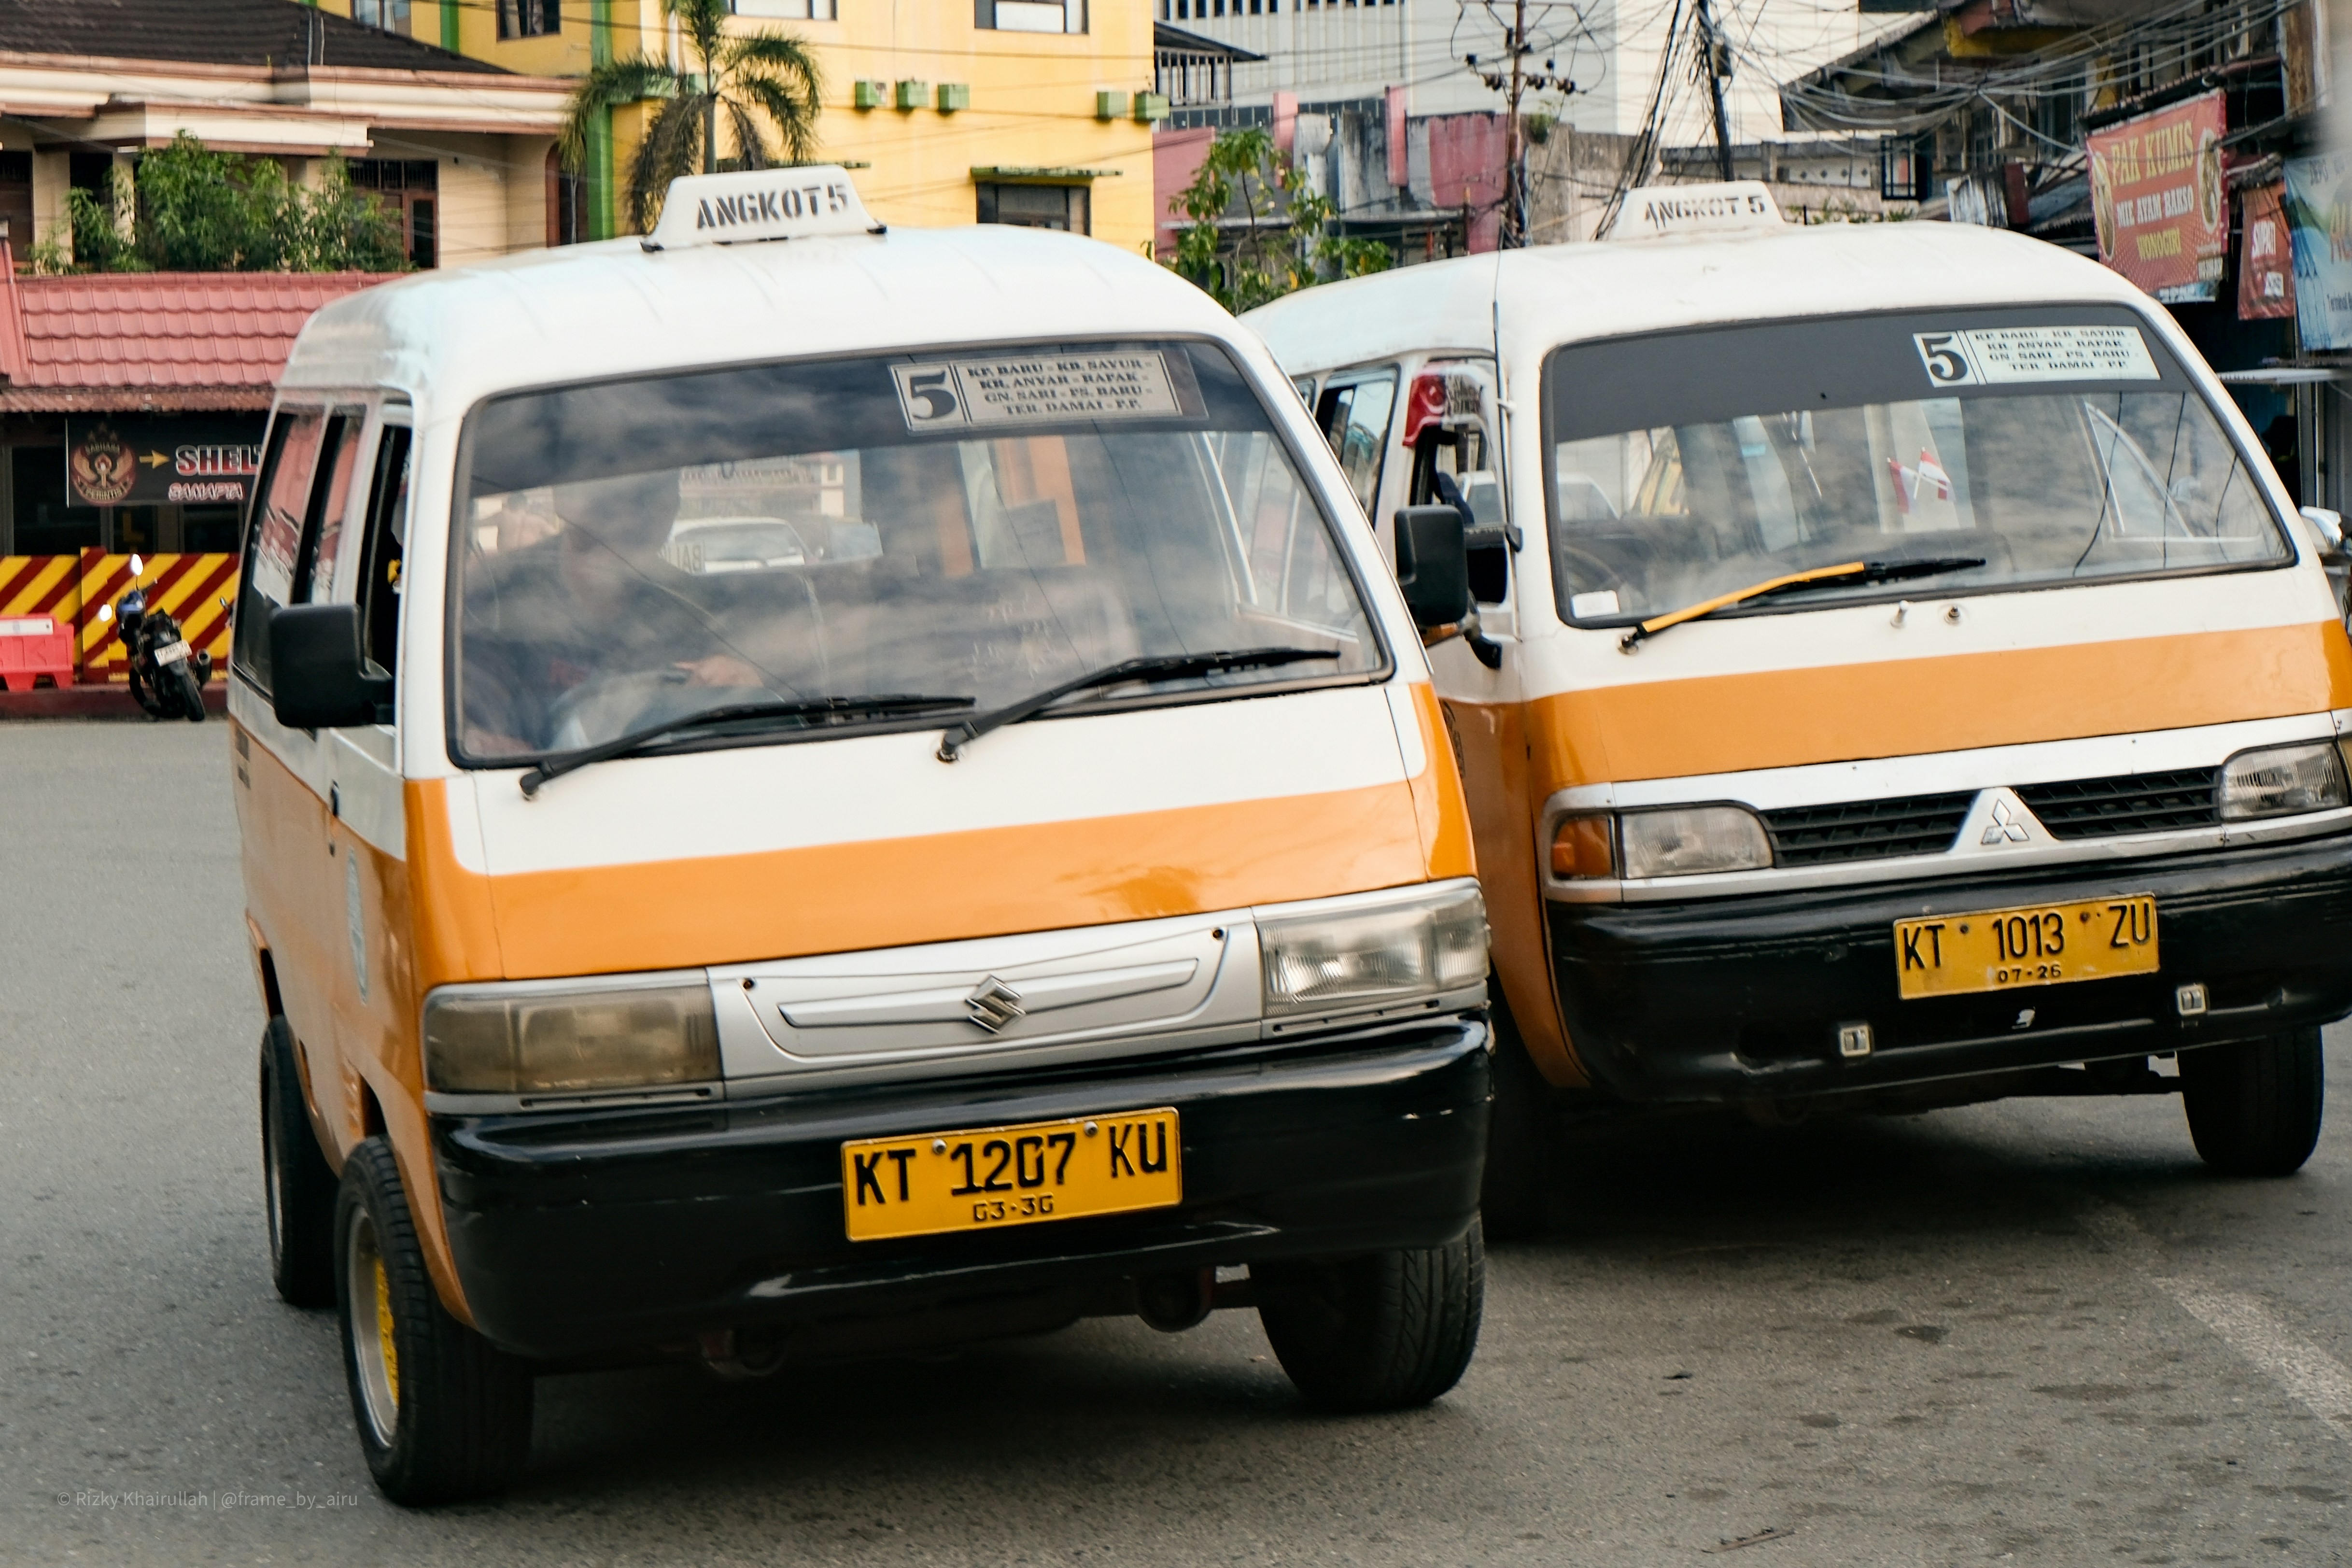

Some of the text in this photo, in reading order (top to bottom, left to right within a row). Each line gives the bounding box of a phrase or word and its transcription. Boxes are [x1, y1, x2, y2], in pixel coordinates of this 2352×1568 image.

[2111, 119, 2194, 186] PAK KUMIS
[697, 182, 848, 230] ANGKOT 5
[1747, 195, 1766, 214] 5
[2116, 183, 2195, 228] MIE AYAM BAKSO
[2000, 331, 2039, 339] BARU
[2080, 329, 2126, 338] SAYUR
[2017, 340, 2063, 350] ANYAR
[2076, 339, 2123, 348] RAPAK
[1921, 336, 1968, 381] 5
[2017, 351, 2052, 360] SARI
[2092, 350, 2130, 358] BARU
[997, 363, 1043, 375] BARU
[1087, 359, 1142, 370] SAYUR
[2048, 360, 2095, 369] DAMAI
[1013, 375, 1069, 387] ANYAR
[1082, 372, 1138, 383] RAPAK
[910, 370, 957, 419] 5
[1016, 388, 1057, 400] SARI
[1096, 385, 1142, 396] BARU
[1045, 400, 1103, 412] DAMAI
[1903, 902, 2151, 971] KT 1013 ZU
[854, 1120, 1167, 1206] KT 1207 KU
